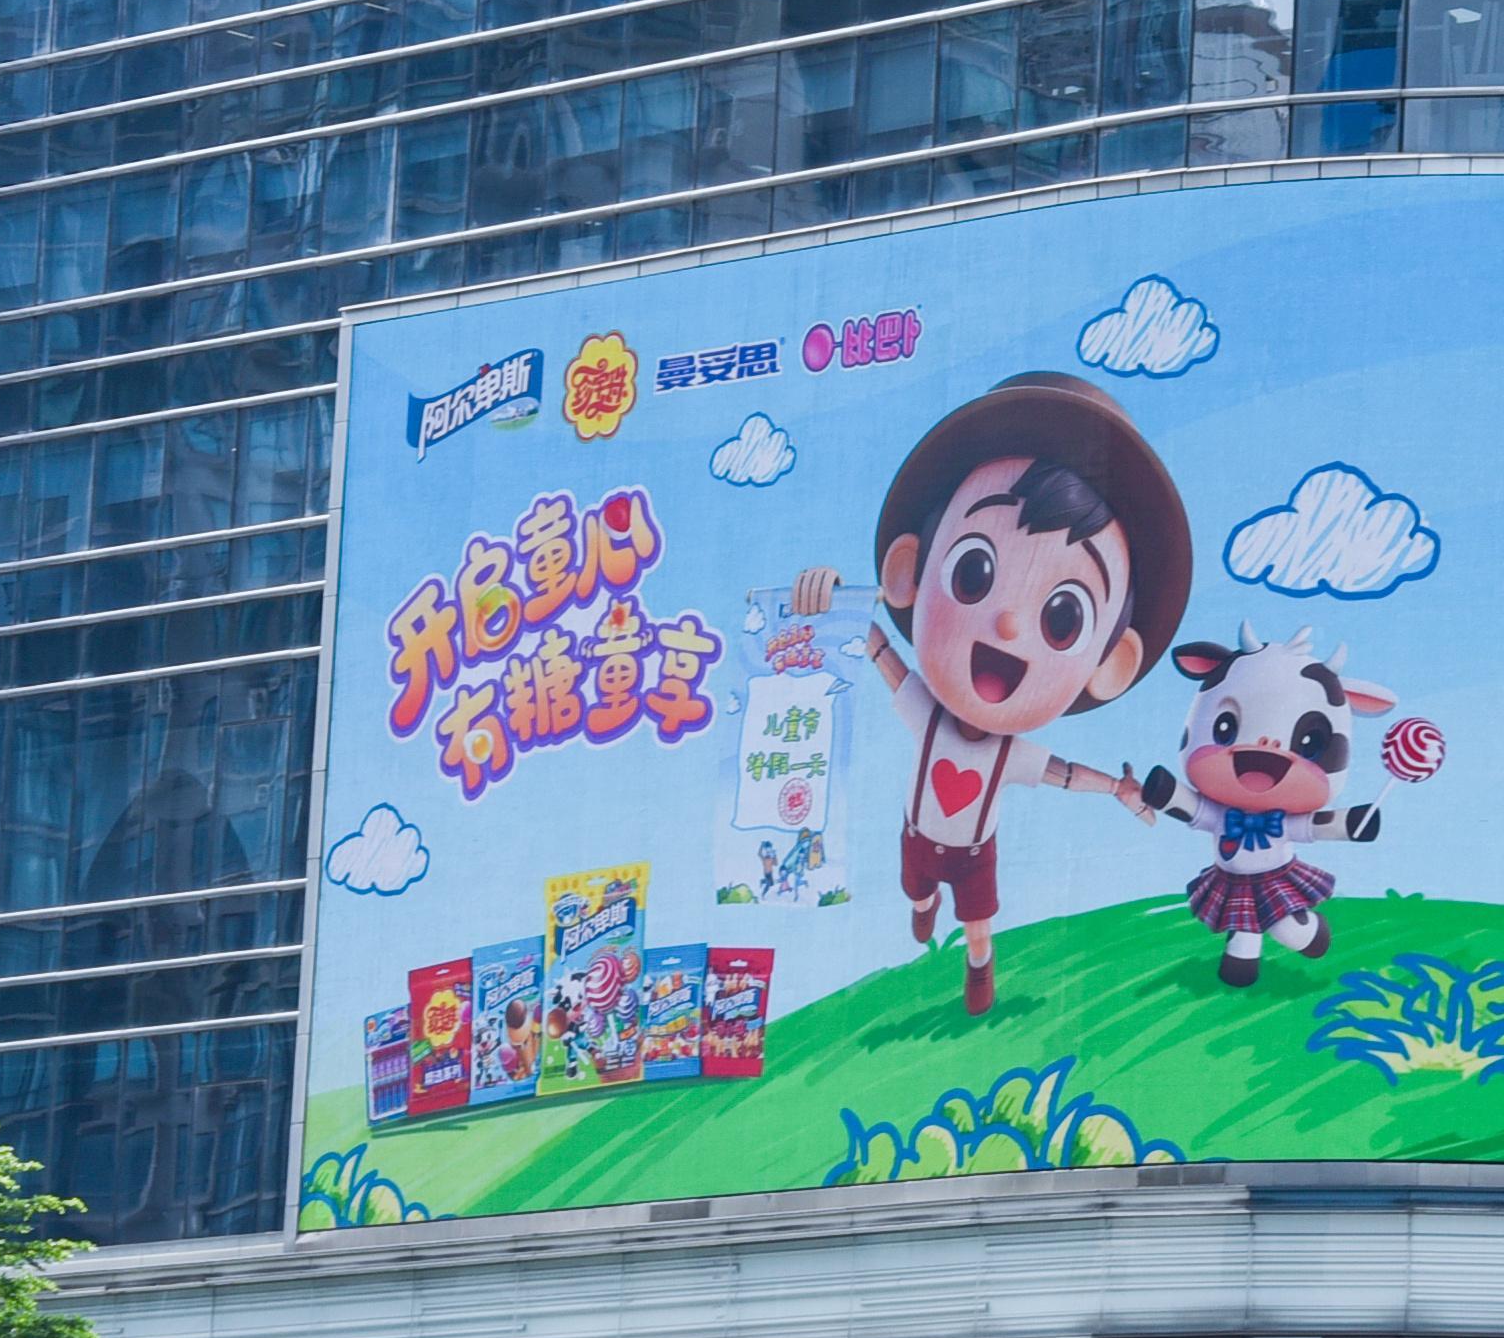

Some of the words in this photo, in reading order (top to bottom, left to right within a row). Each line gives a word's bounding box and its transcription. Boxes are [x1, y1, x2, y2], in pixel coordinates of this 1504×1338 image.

[655, 341, 783, 393] 曼妥思
[842, 311, 922, 368] 比巴卜
[416, 351, 534, 462] 阿尔卑斯
[390, 490, 662, 737] 开启童心
